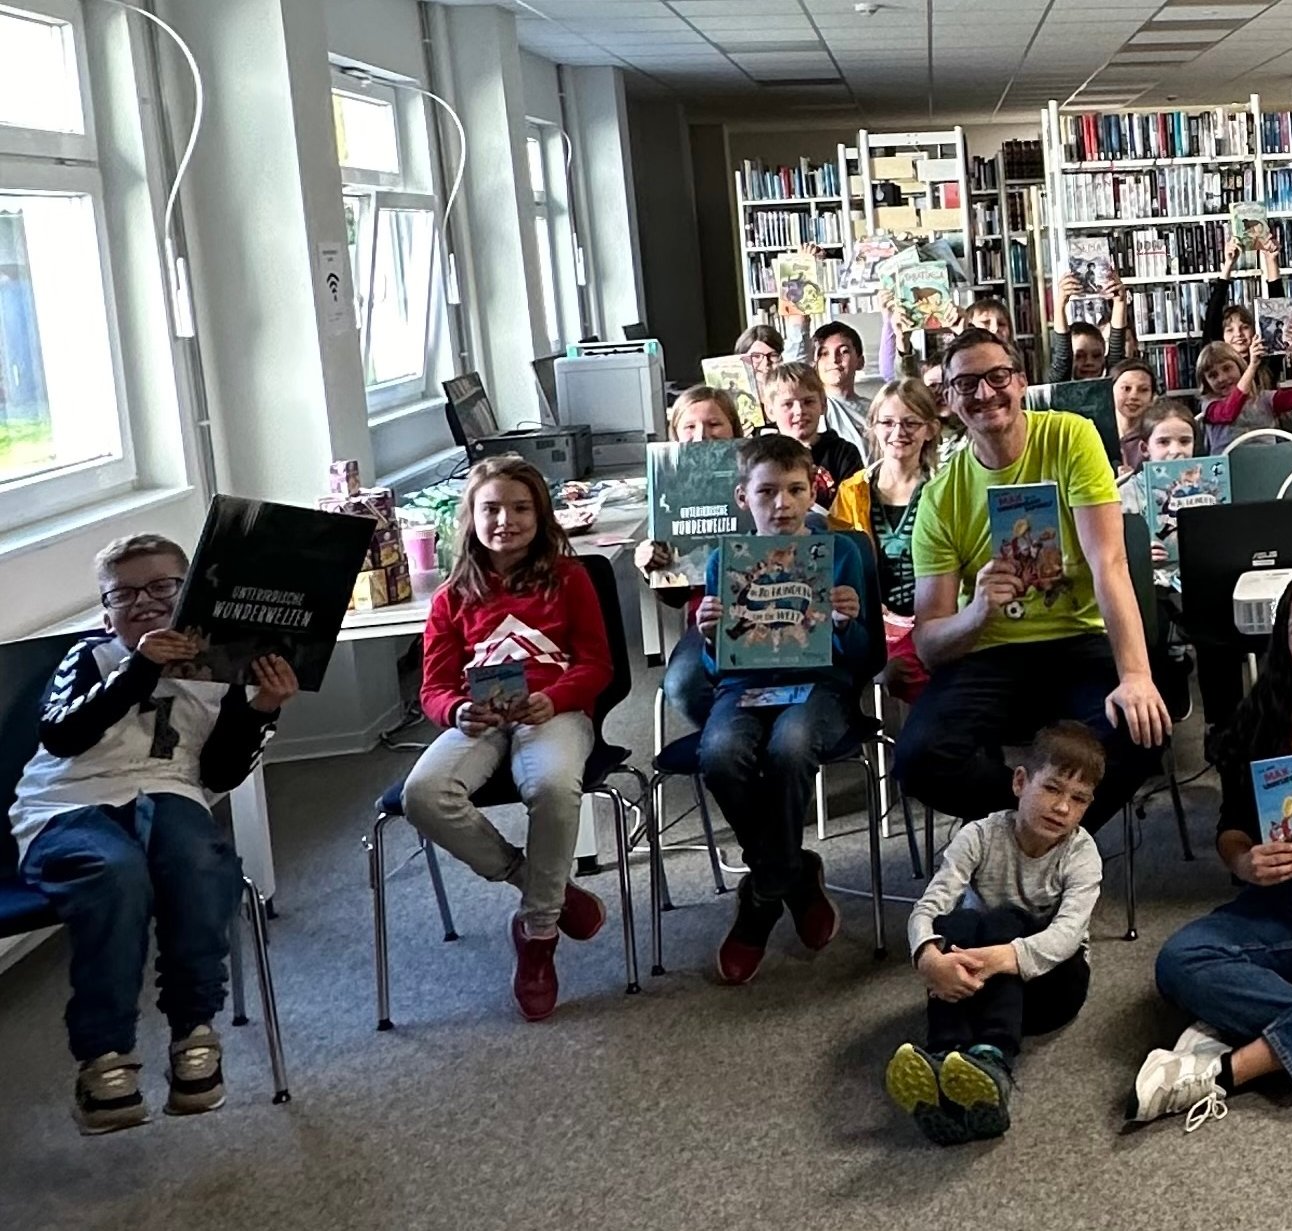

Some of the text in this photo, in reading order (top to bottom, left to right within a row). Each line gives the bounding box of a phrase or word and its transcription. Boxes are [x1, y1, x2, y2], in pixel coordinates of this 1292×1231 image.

[671, 516, 738, 536] WUNDERWELTEN
[212, 600, 313, 628] WUNDERWELTEN
[1263, 767, 1289, 782] MAX
